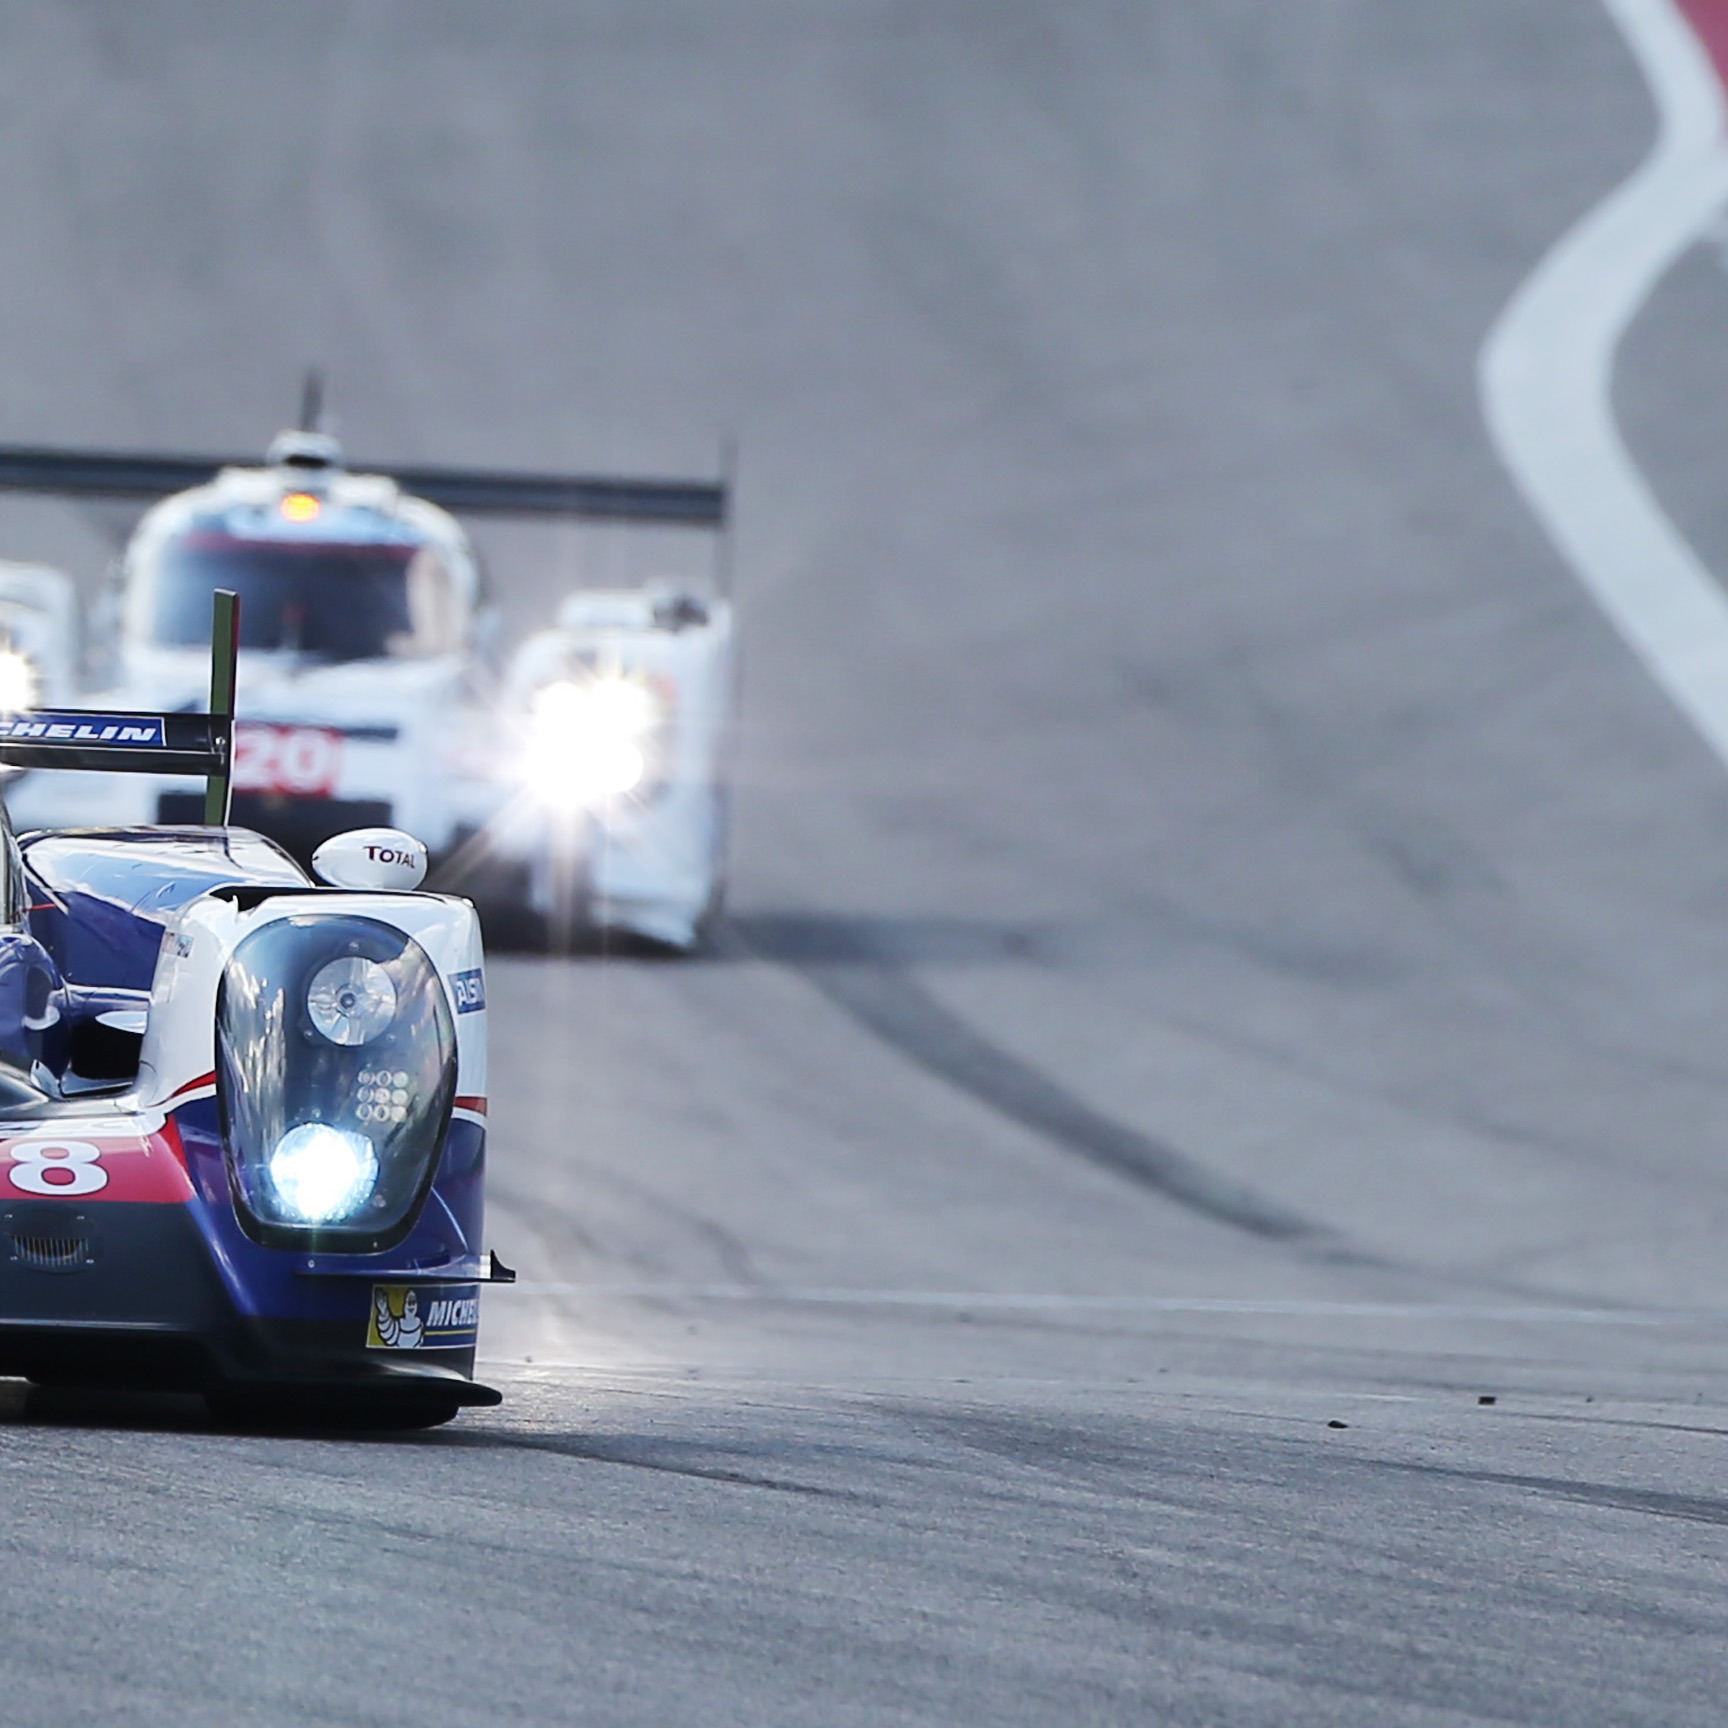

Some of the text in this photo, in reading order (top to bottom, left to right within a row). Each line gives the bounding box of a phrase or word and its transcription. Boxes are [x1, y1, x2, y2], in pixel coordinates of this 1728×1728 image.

[235, 728, 332, 793] 20
[363, 846, 416, 869] TOTAL
[8, 1140, 110, 1196] 8
